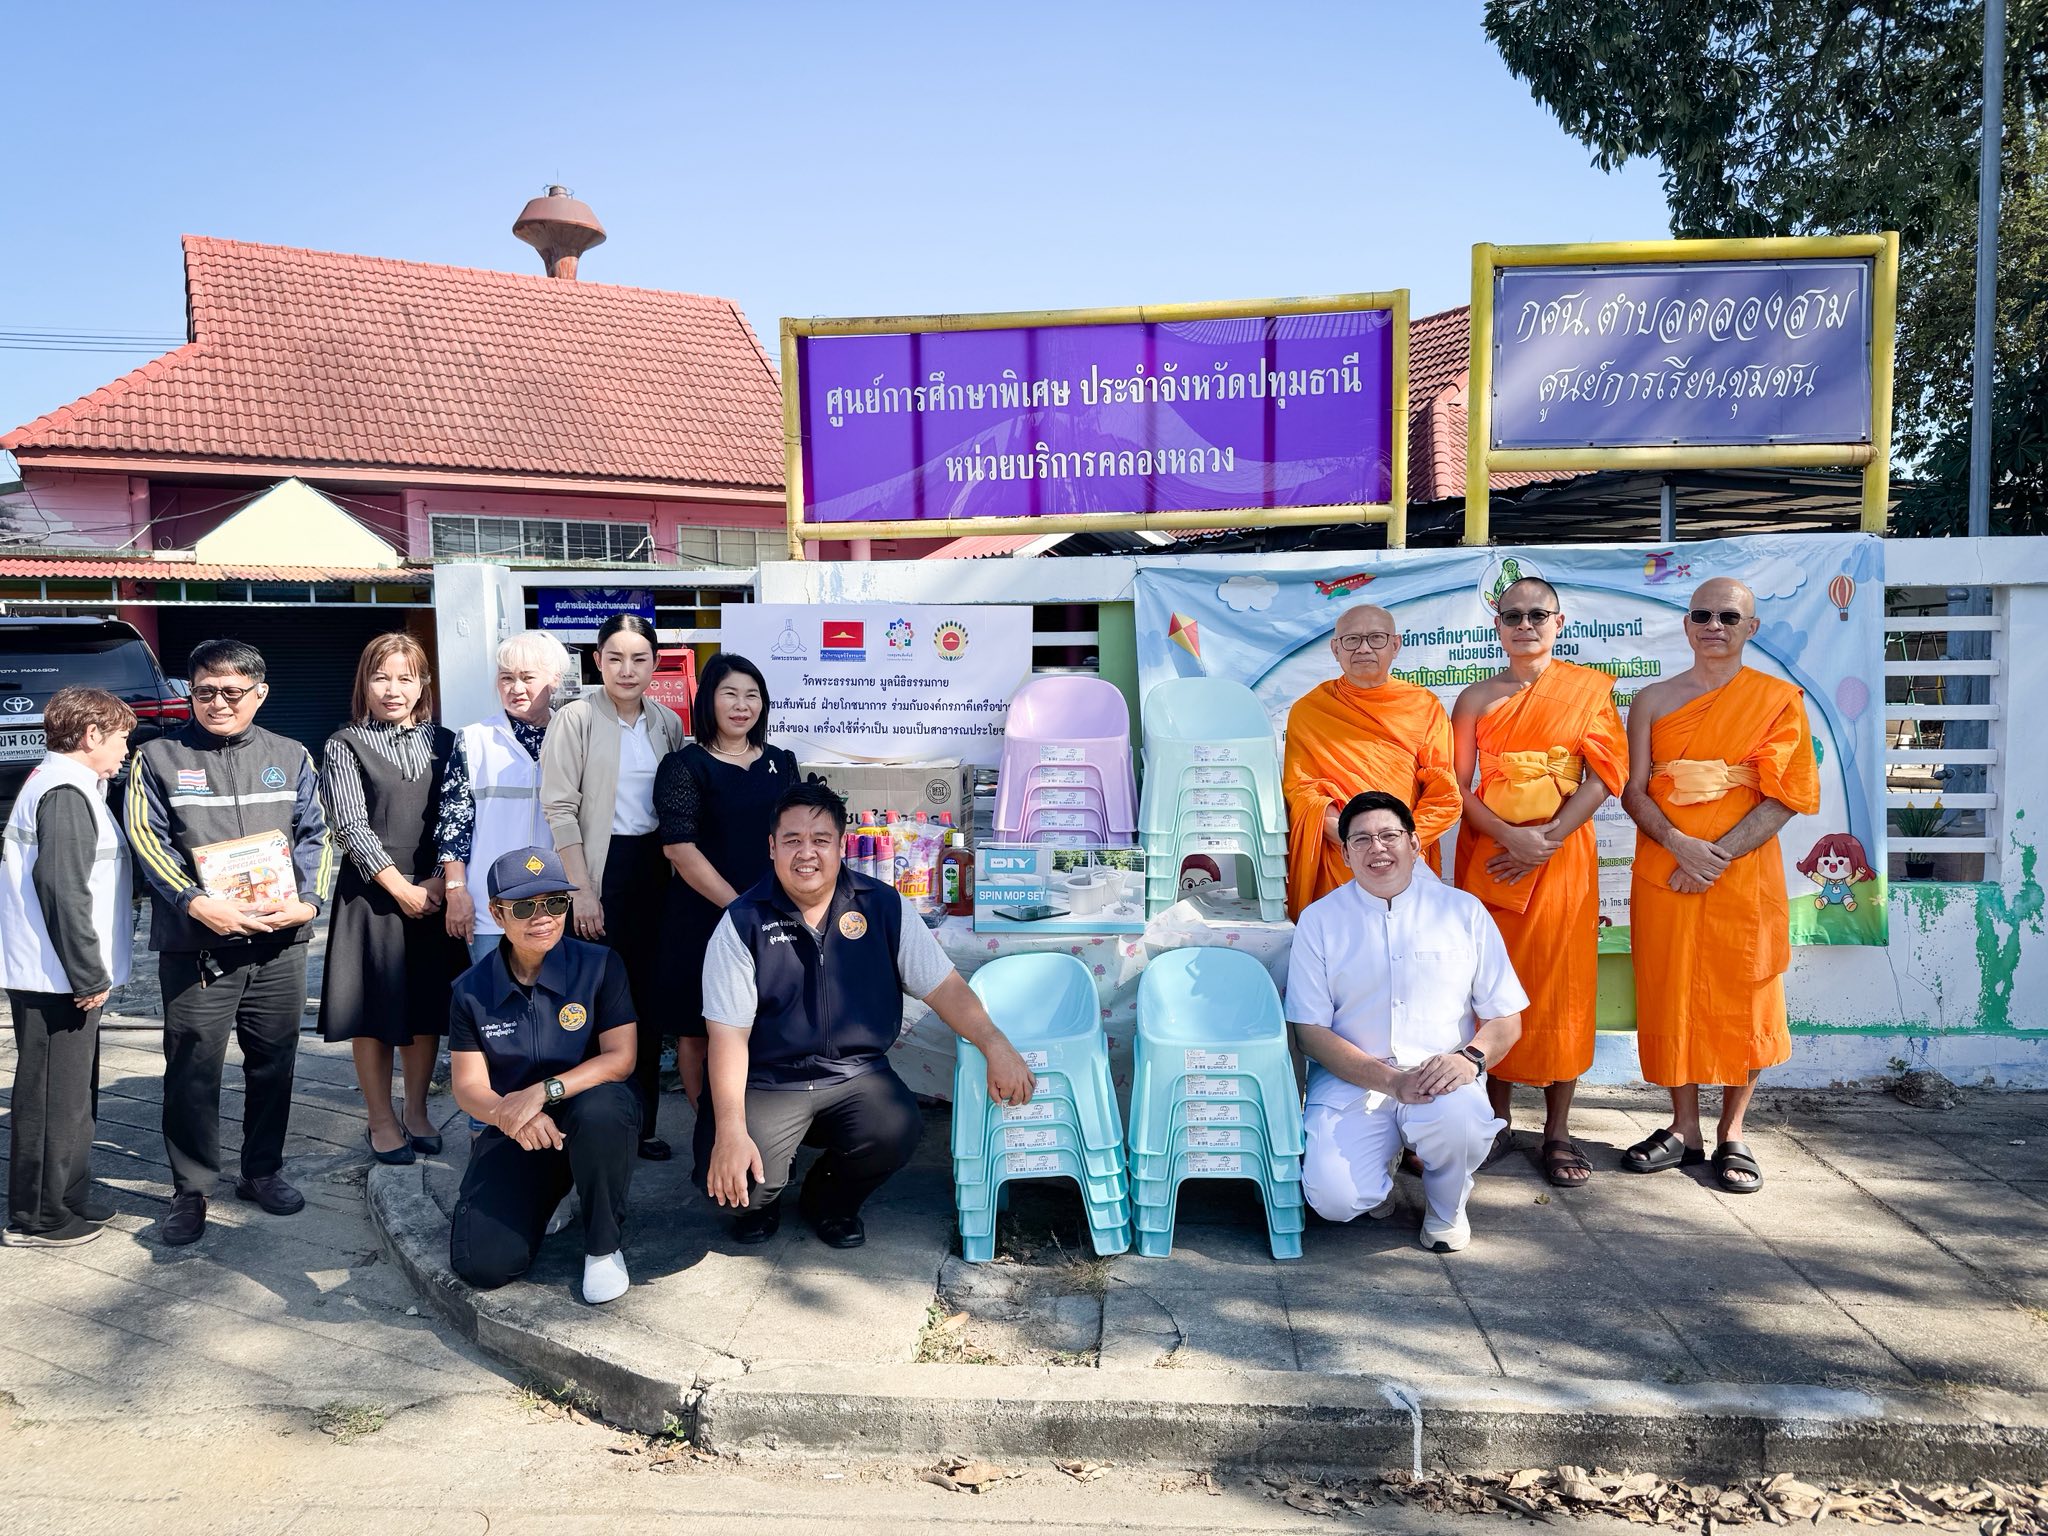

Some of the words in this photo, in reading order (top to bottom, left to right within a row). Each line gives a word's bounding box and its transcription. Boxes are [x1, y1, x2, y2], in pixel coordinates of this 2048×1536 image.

[826, 370, 1071, 427] ศูนย์การศึกษาพิเศษ
[1081, 351, 1363, 410] ประจำจังหวัดปทุมธานี
[1540, 355, 1822, 423] ศูนย์การเรียนชุมชน
[945, 440, 1235, 484] หน่วยบริการคลองหลวง
[802, 675, 876, 688] วัดพระธรรมกาย
[880, 675, 950, 691] มูลนิธิธรรมกาย
[821, 696, 887, 711] ฝ่ายโภชนาการ
[891, 696, 1011, 711] ร่วมกับองค์กรภาคีเครือข่า
[813, 716, 888, 735] เครื่องใช้ที่จำเป็น
[990, 857, 1031, 869] DIY
[979, 890, 1002, 901] SPIN
[1004, 890, 1025, 901] MOP
[1027, 890, 1046, 901] SET
